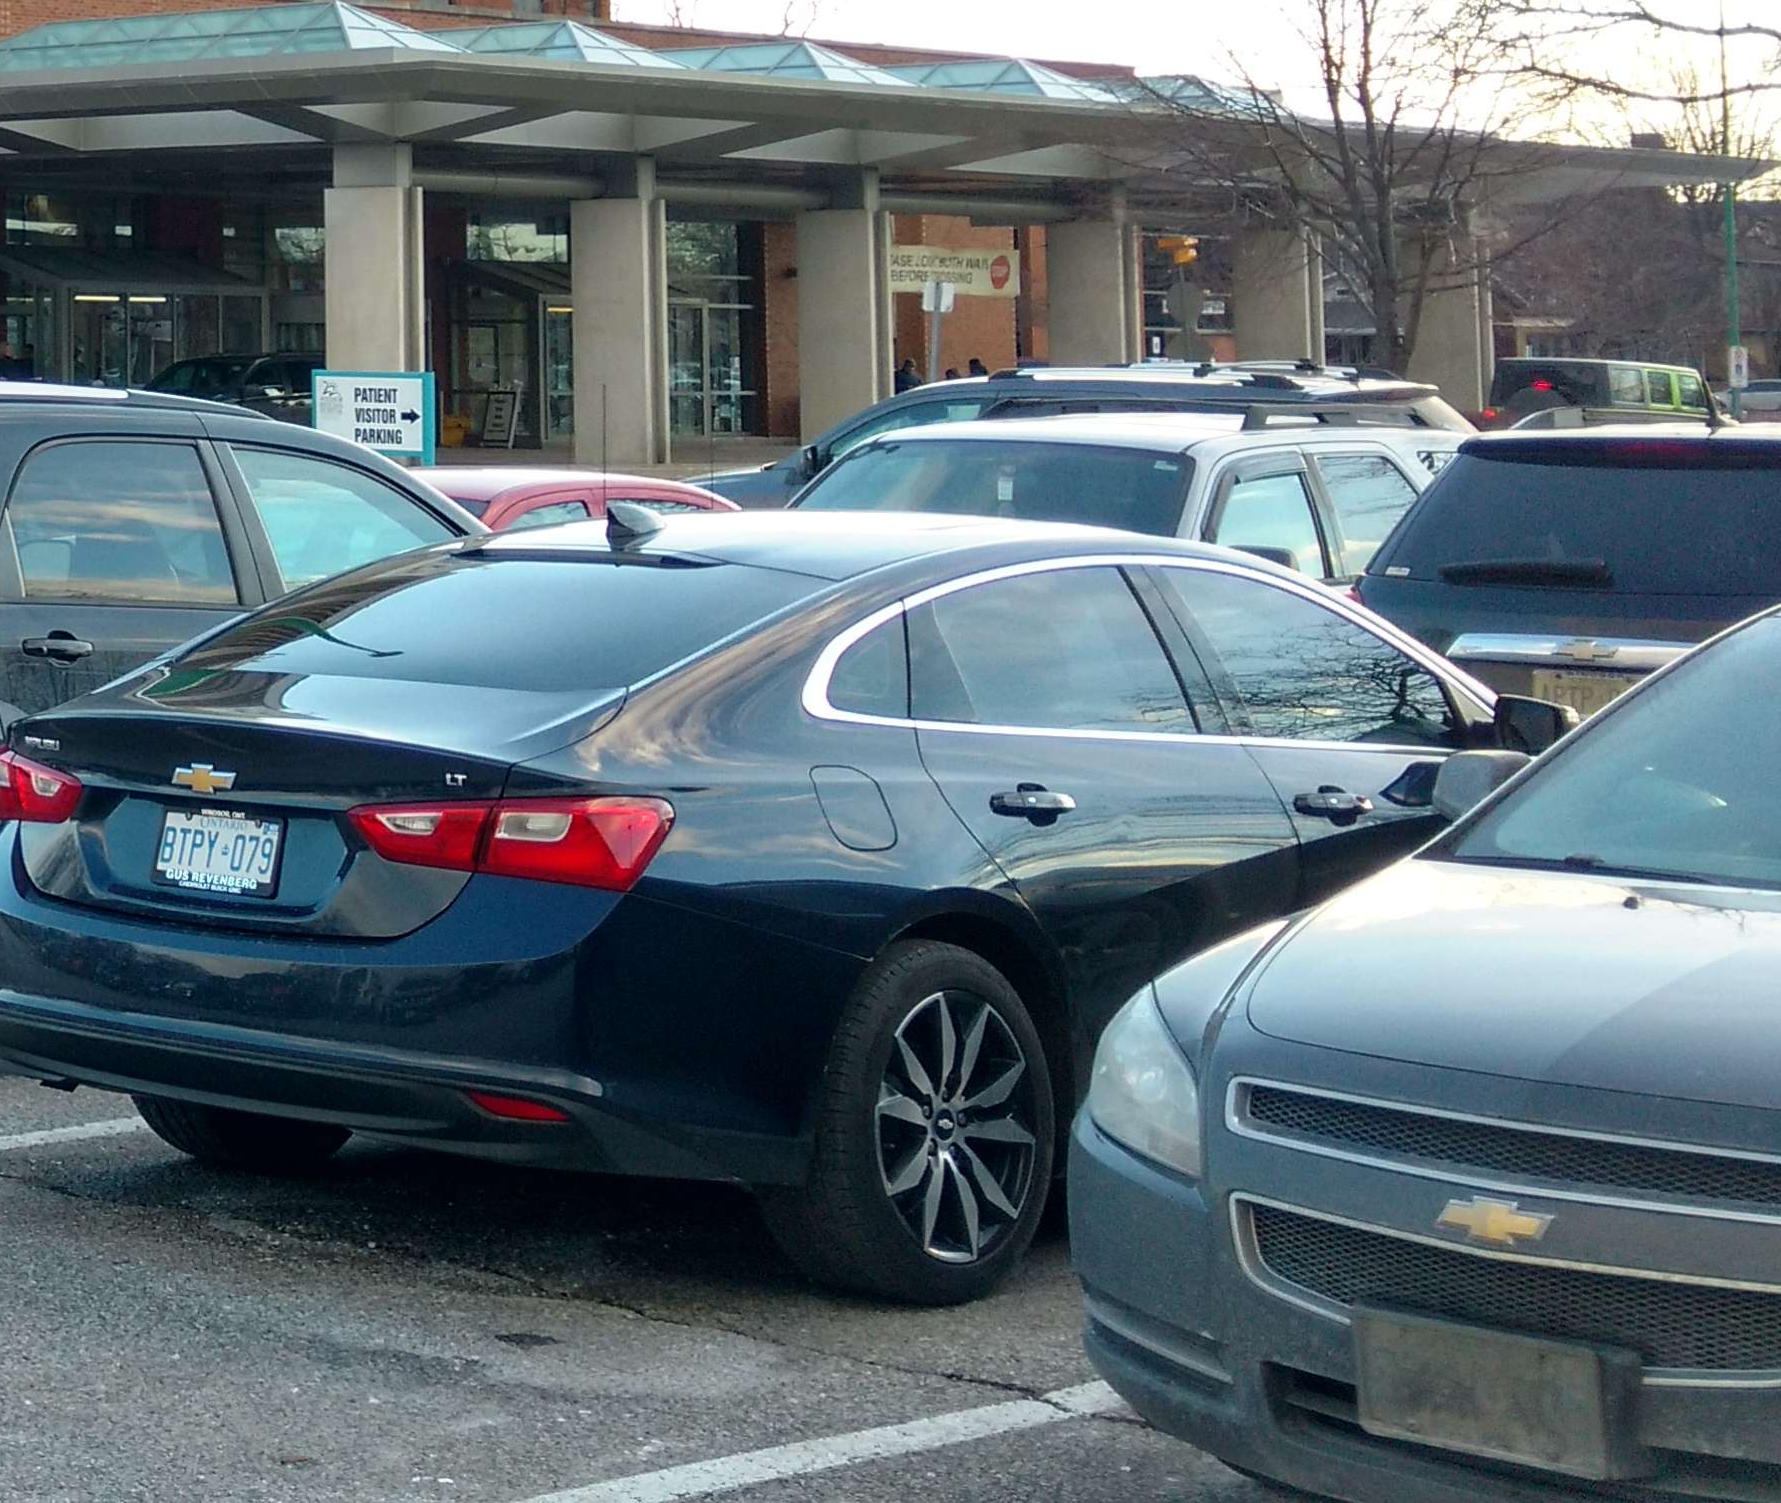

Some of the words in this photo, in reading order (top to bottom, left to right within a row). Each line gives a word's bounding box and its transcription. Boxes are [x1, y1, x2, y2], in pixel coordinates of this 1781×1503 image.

[354, 387, 398, 403] PATIENT
[354, 408, 396, 423] VISITOR
[354, 428, 402, 444] PARKING
[446, 773, 467, 786] LT
[200, 817, 246, 830] ONTARIO
[160, 826, 219, 868] BTPY
[230, 834, 274, 875] 079
[166, 869, 189, 881] GUS
[192, 872, 257, 889] REVENBERG
